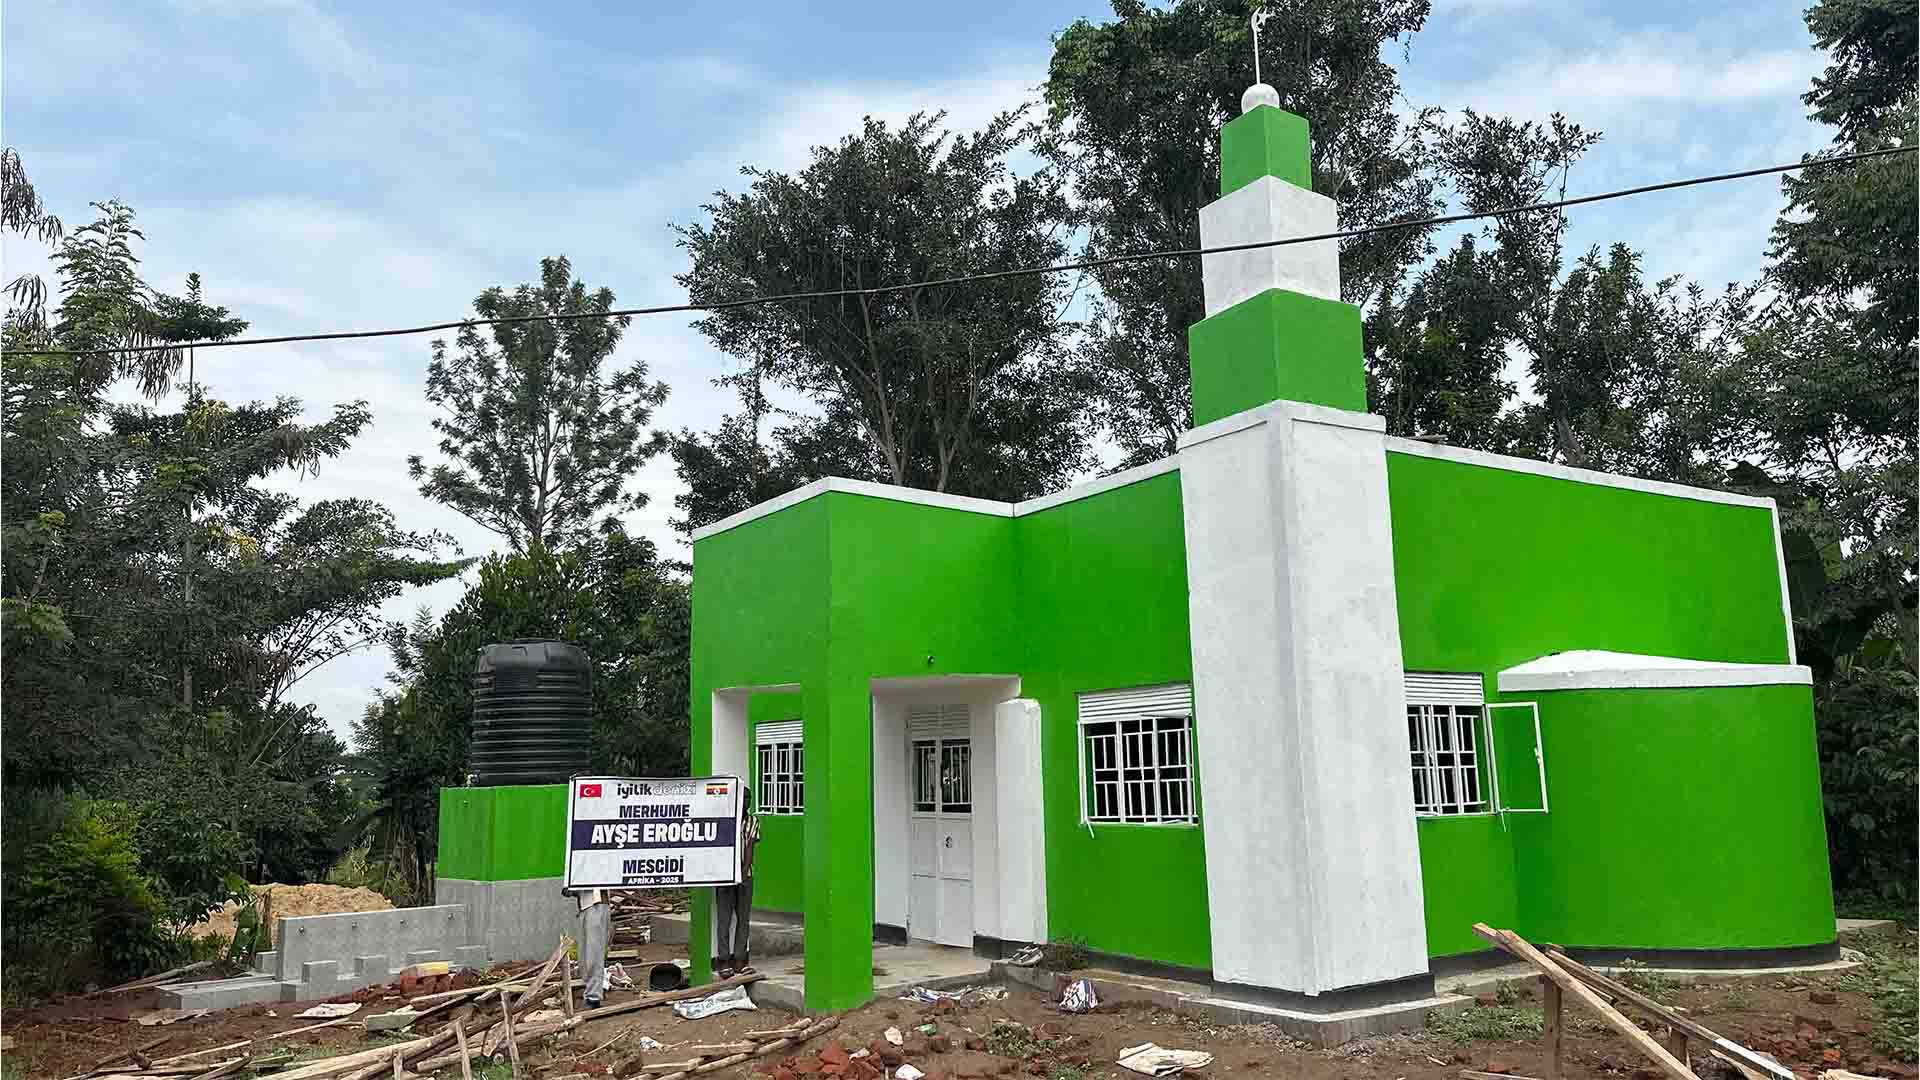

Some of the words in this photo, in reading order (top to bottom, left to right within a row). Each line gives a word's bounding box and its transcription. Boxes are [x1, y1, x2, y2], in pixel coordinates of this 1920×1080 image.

[619, 804, 690, 818] MERHUME
[591, 823, 640, 848] AYŞE
[643, 818, 718, 843] EROĞLU
[622, 855, 684, 874] MESCİDİ
[627, 876, 655, 884] AFRİKA
